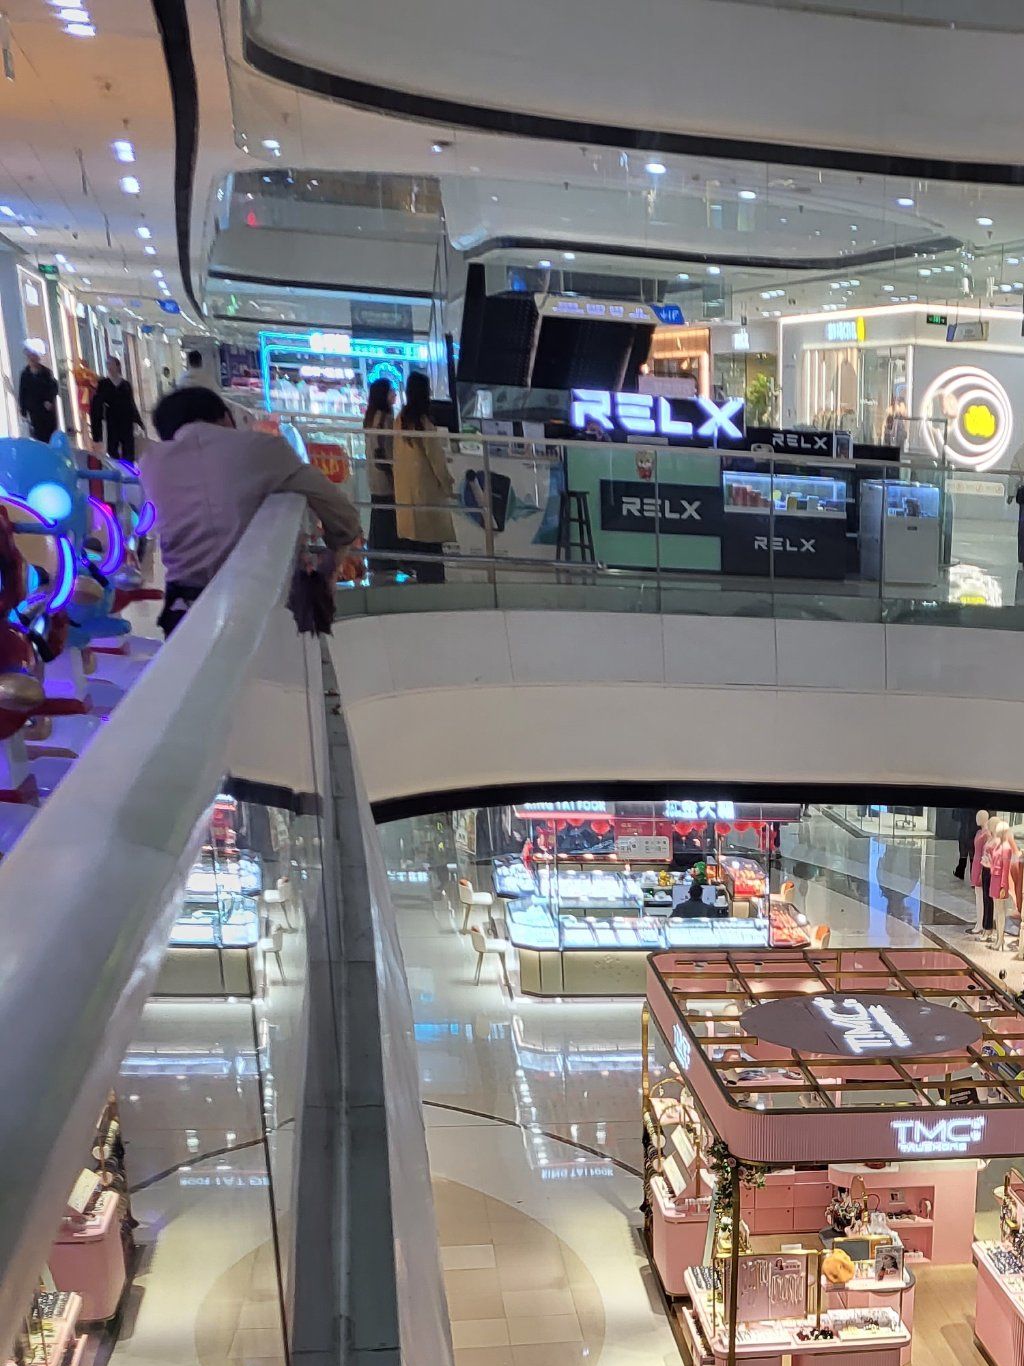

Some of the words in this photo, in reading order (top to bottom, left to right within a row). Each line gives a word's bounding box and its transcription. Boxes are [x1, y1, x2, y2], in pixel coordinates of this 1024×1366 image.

[570, 388, 745, 439] RELX
[772, 433, 828, 450] RELX
[621, 496, 702, 520] RELX
[754, 535, 816, 553] RELX
